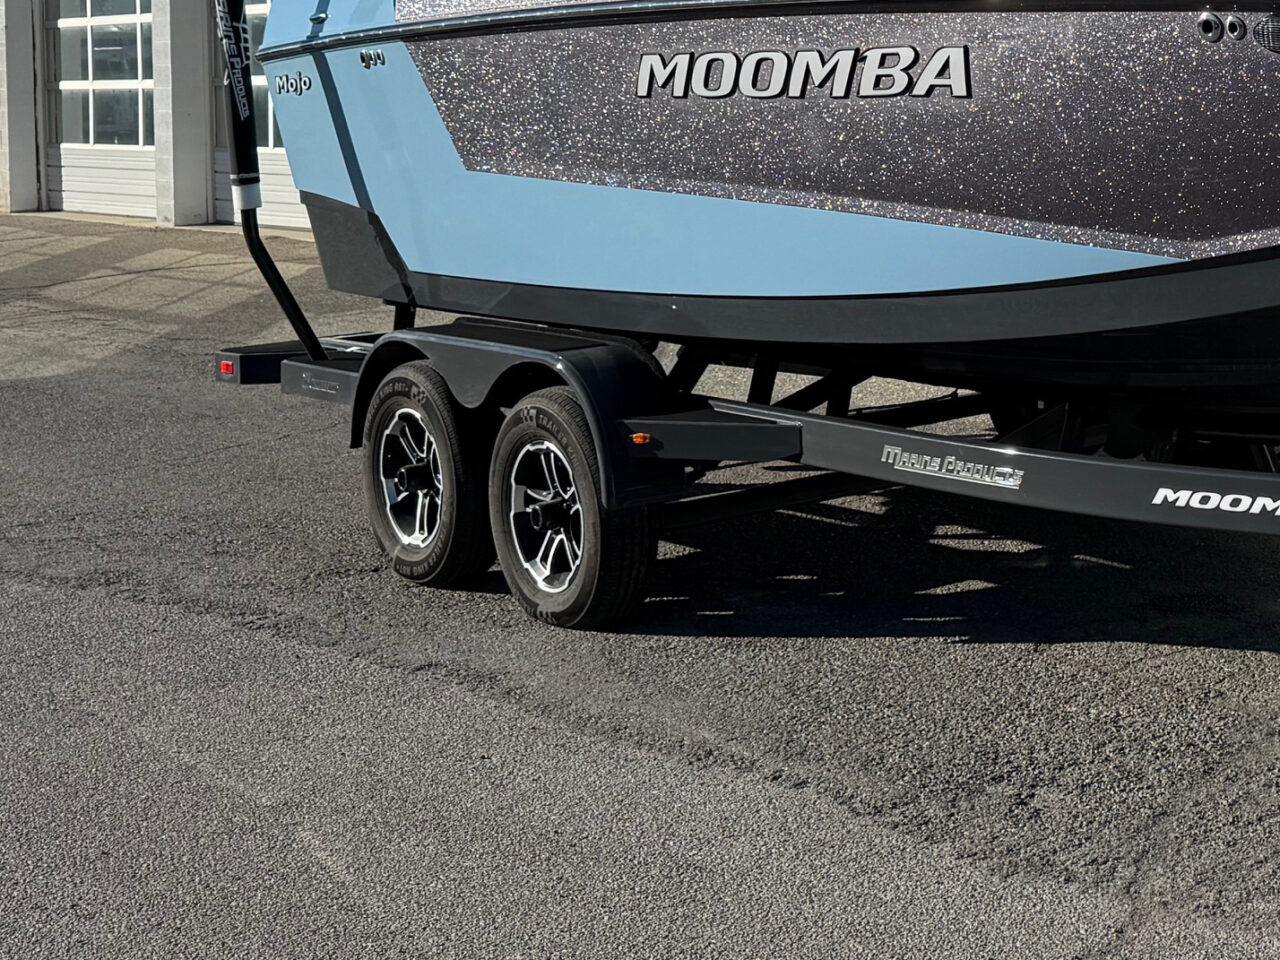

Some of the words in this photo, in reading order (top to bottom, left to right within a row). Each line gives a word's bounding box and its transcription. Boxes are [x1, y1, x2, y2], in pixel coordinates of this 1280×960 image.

[229, 55, 250, 118] PRODUCTS
[275, 71, 312, 96] Mojo
[636, 44, 972, 99] MOOMBA
[880, 445, 942, 470] MARINE
